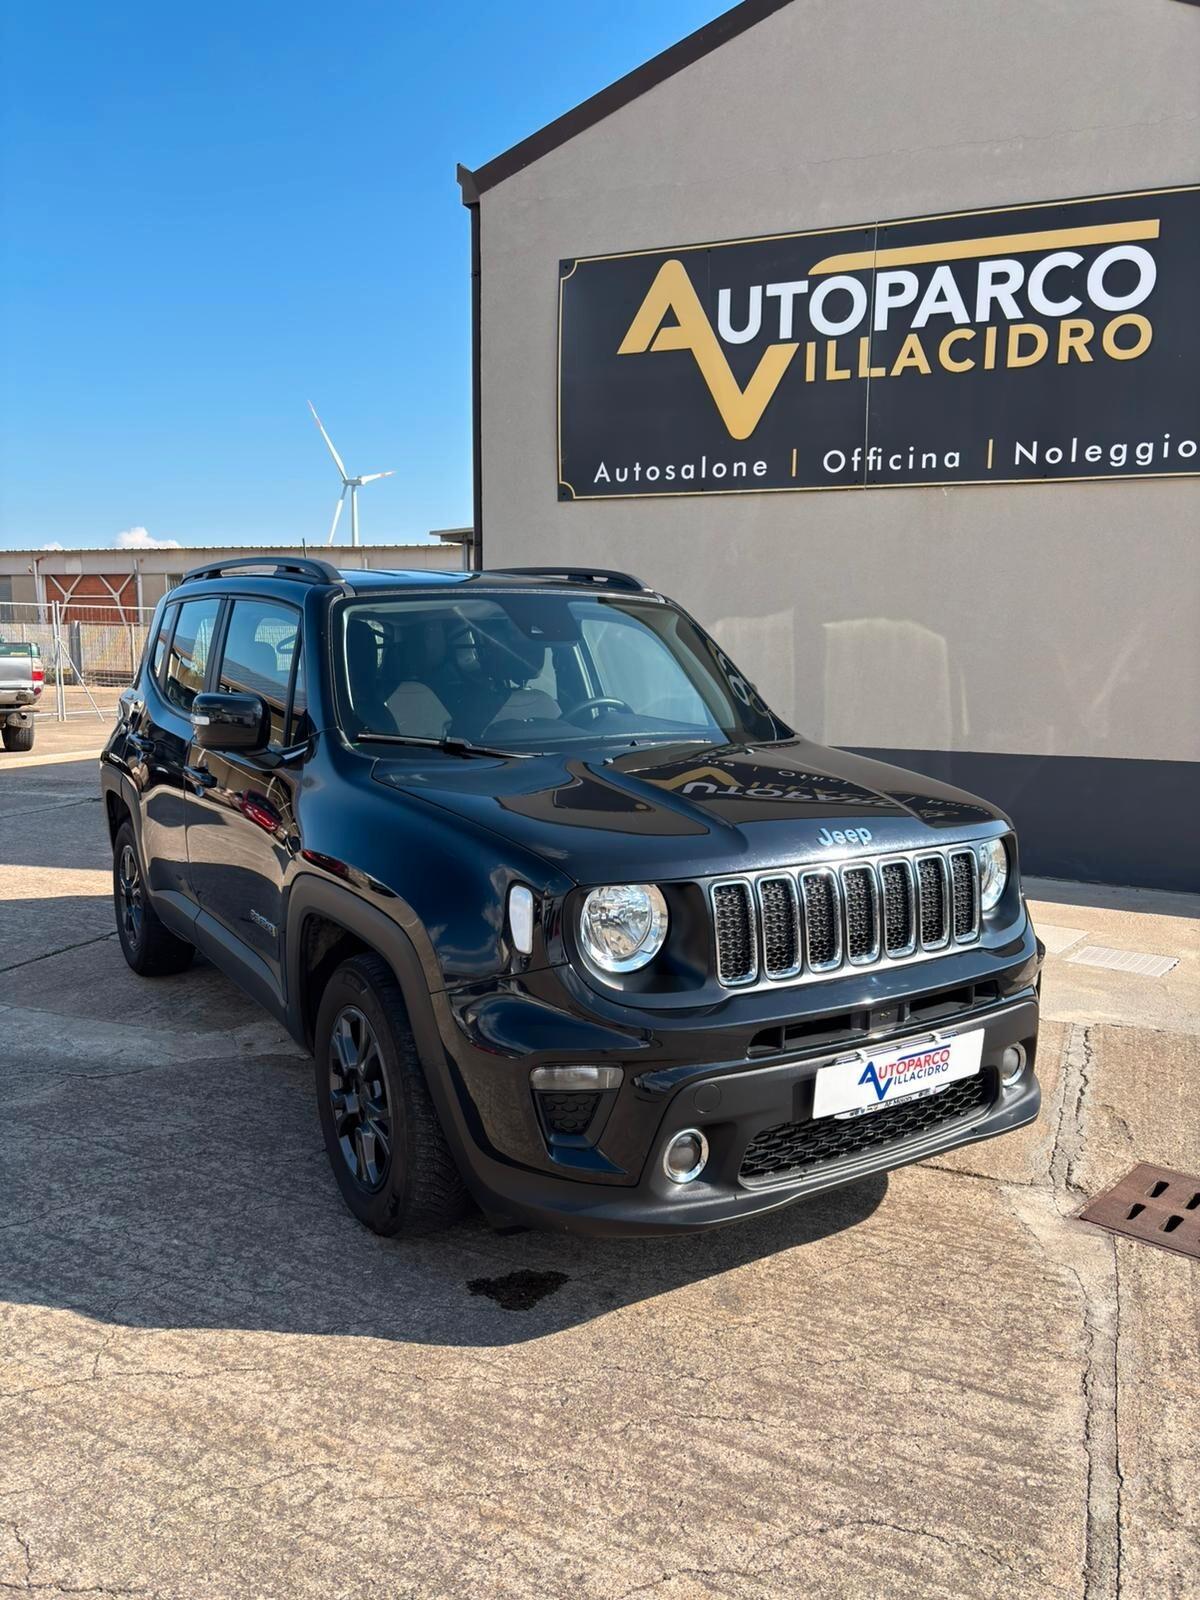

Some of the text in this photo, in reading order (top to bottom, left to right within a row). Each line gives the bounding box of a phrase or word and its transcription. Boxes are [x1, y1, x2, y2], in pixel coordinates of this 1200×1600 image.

[616, 244, 1158, 355] AUTOPARCO
[693, 314, 1153, 440] VILLACIDRO
[593, 433, 1198, 483] Autosalone Officina Noleggio
[816, 827, 873, 847] Jeep
[858, 1049, 950, 1086] AUTOPARCO
[873, 1062, 949, 1100] VILLACIDRO
